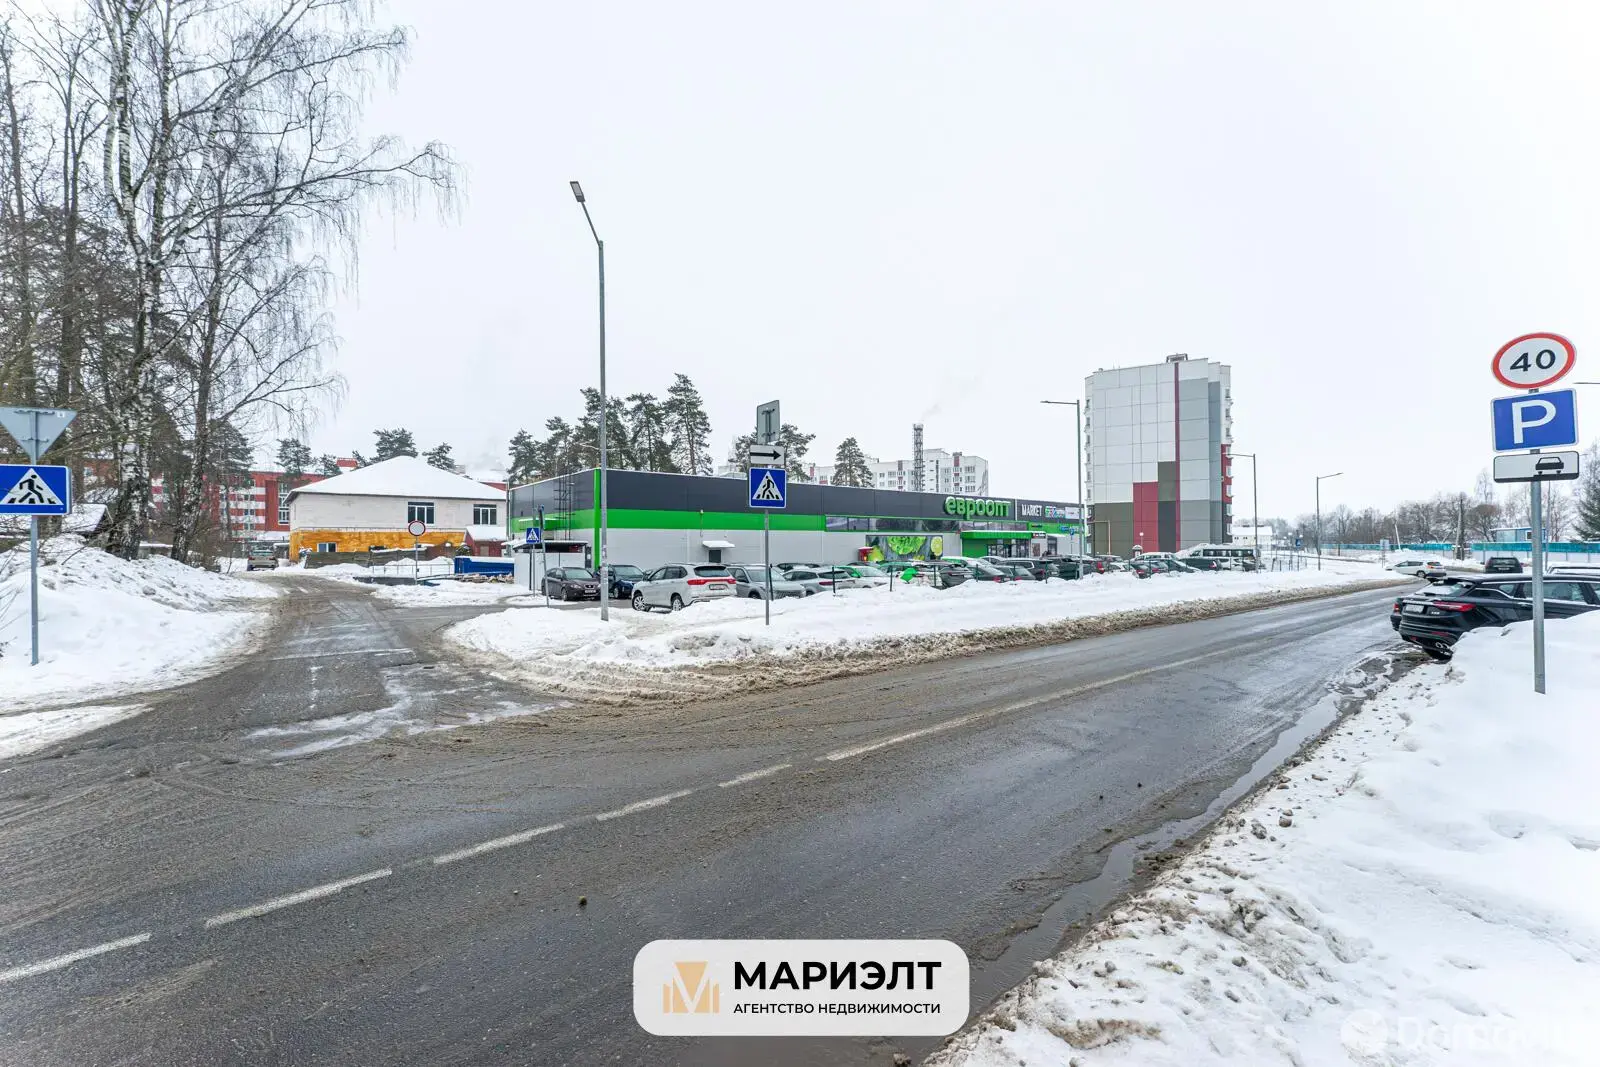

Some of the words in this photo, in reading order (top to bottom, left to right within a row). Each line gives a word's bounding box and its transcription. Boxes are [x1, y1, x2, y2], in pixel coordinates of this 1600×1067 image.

[1510, 349, 1556, 372] 40
[1511, 399, 1557, 444] P
[944, 496, 1011, 520] евроопт
[1021, 504, 1043, 517] MARKET
